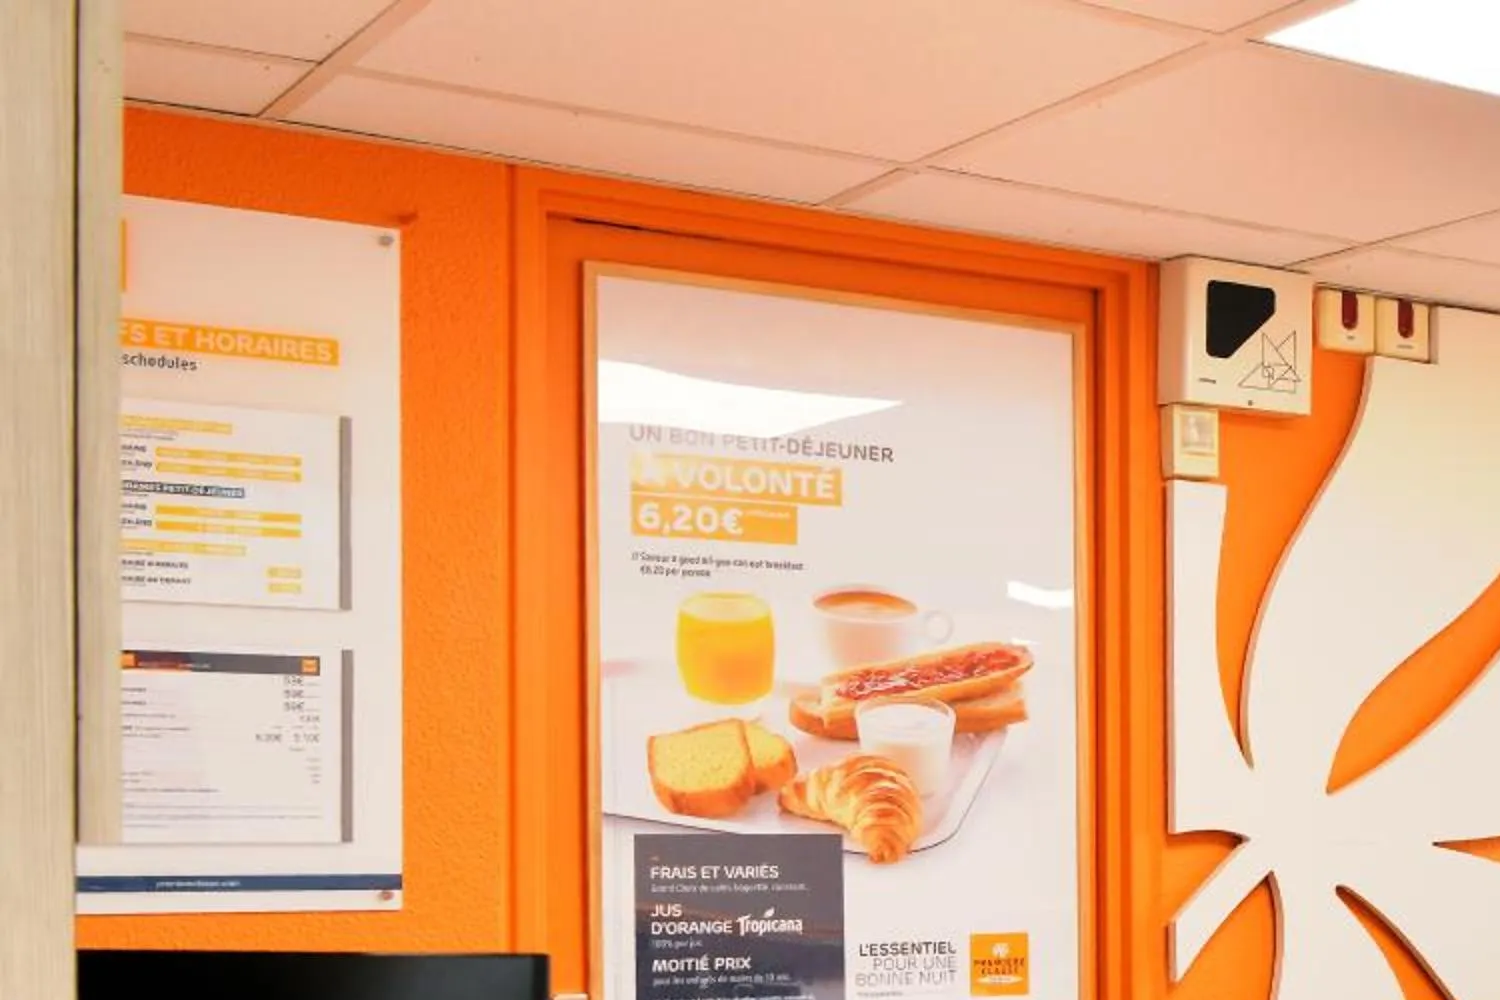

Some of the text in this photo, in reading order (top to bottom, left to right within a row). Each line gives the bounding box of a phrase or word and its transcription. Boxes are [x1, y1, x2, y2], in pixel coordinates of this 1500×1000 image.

[153, 325, 190, 347] ET
[194, 328, 332, 362] HORAIRES
[122, 352, 198, 371] schedules
[629, 424, 894, 462] UN BON PETIT-DÉJEUNER
[673, 463, 835, 499] VOLONTÉ
[638, 502, 744, 535] 6,20€
[651, 863, 779, 879] FRAIS ET VARIÉS
[651, 903, 682, 917] JUS
[651, 913, 803, 936] D'ORANGE Tropicana
[859, 941, 957, 957] L'ESSENTIEL
[652, 954, 752, 973] MOITIÉ PRIX
[873, 956, 957, 971] POUR UNE
[855, 970, 957, 987] BONNE NUIT
